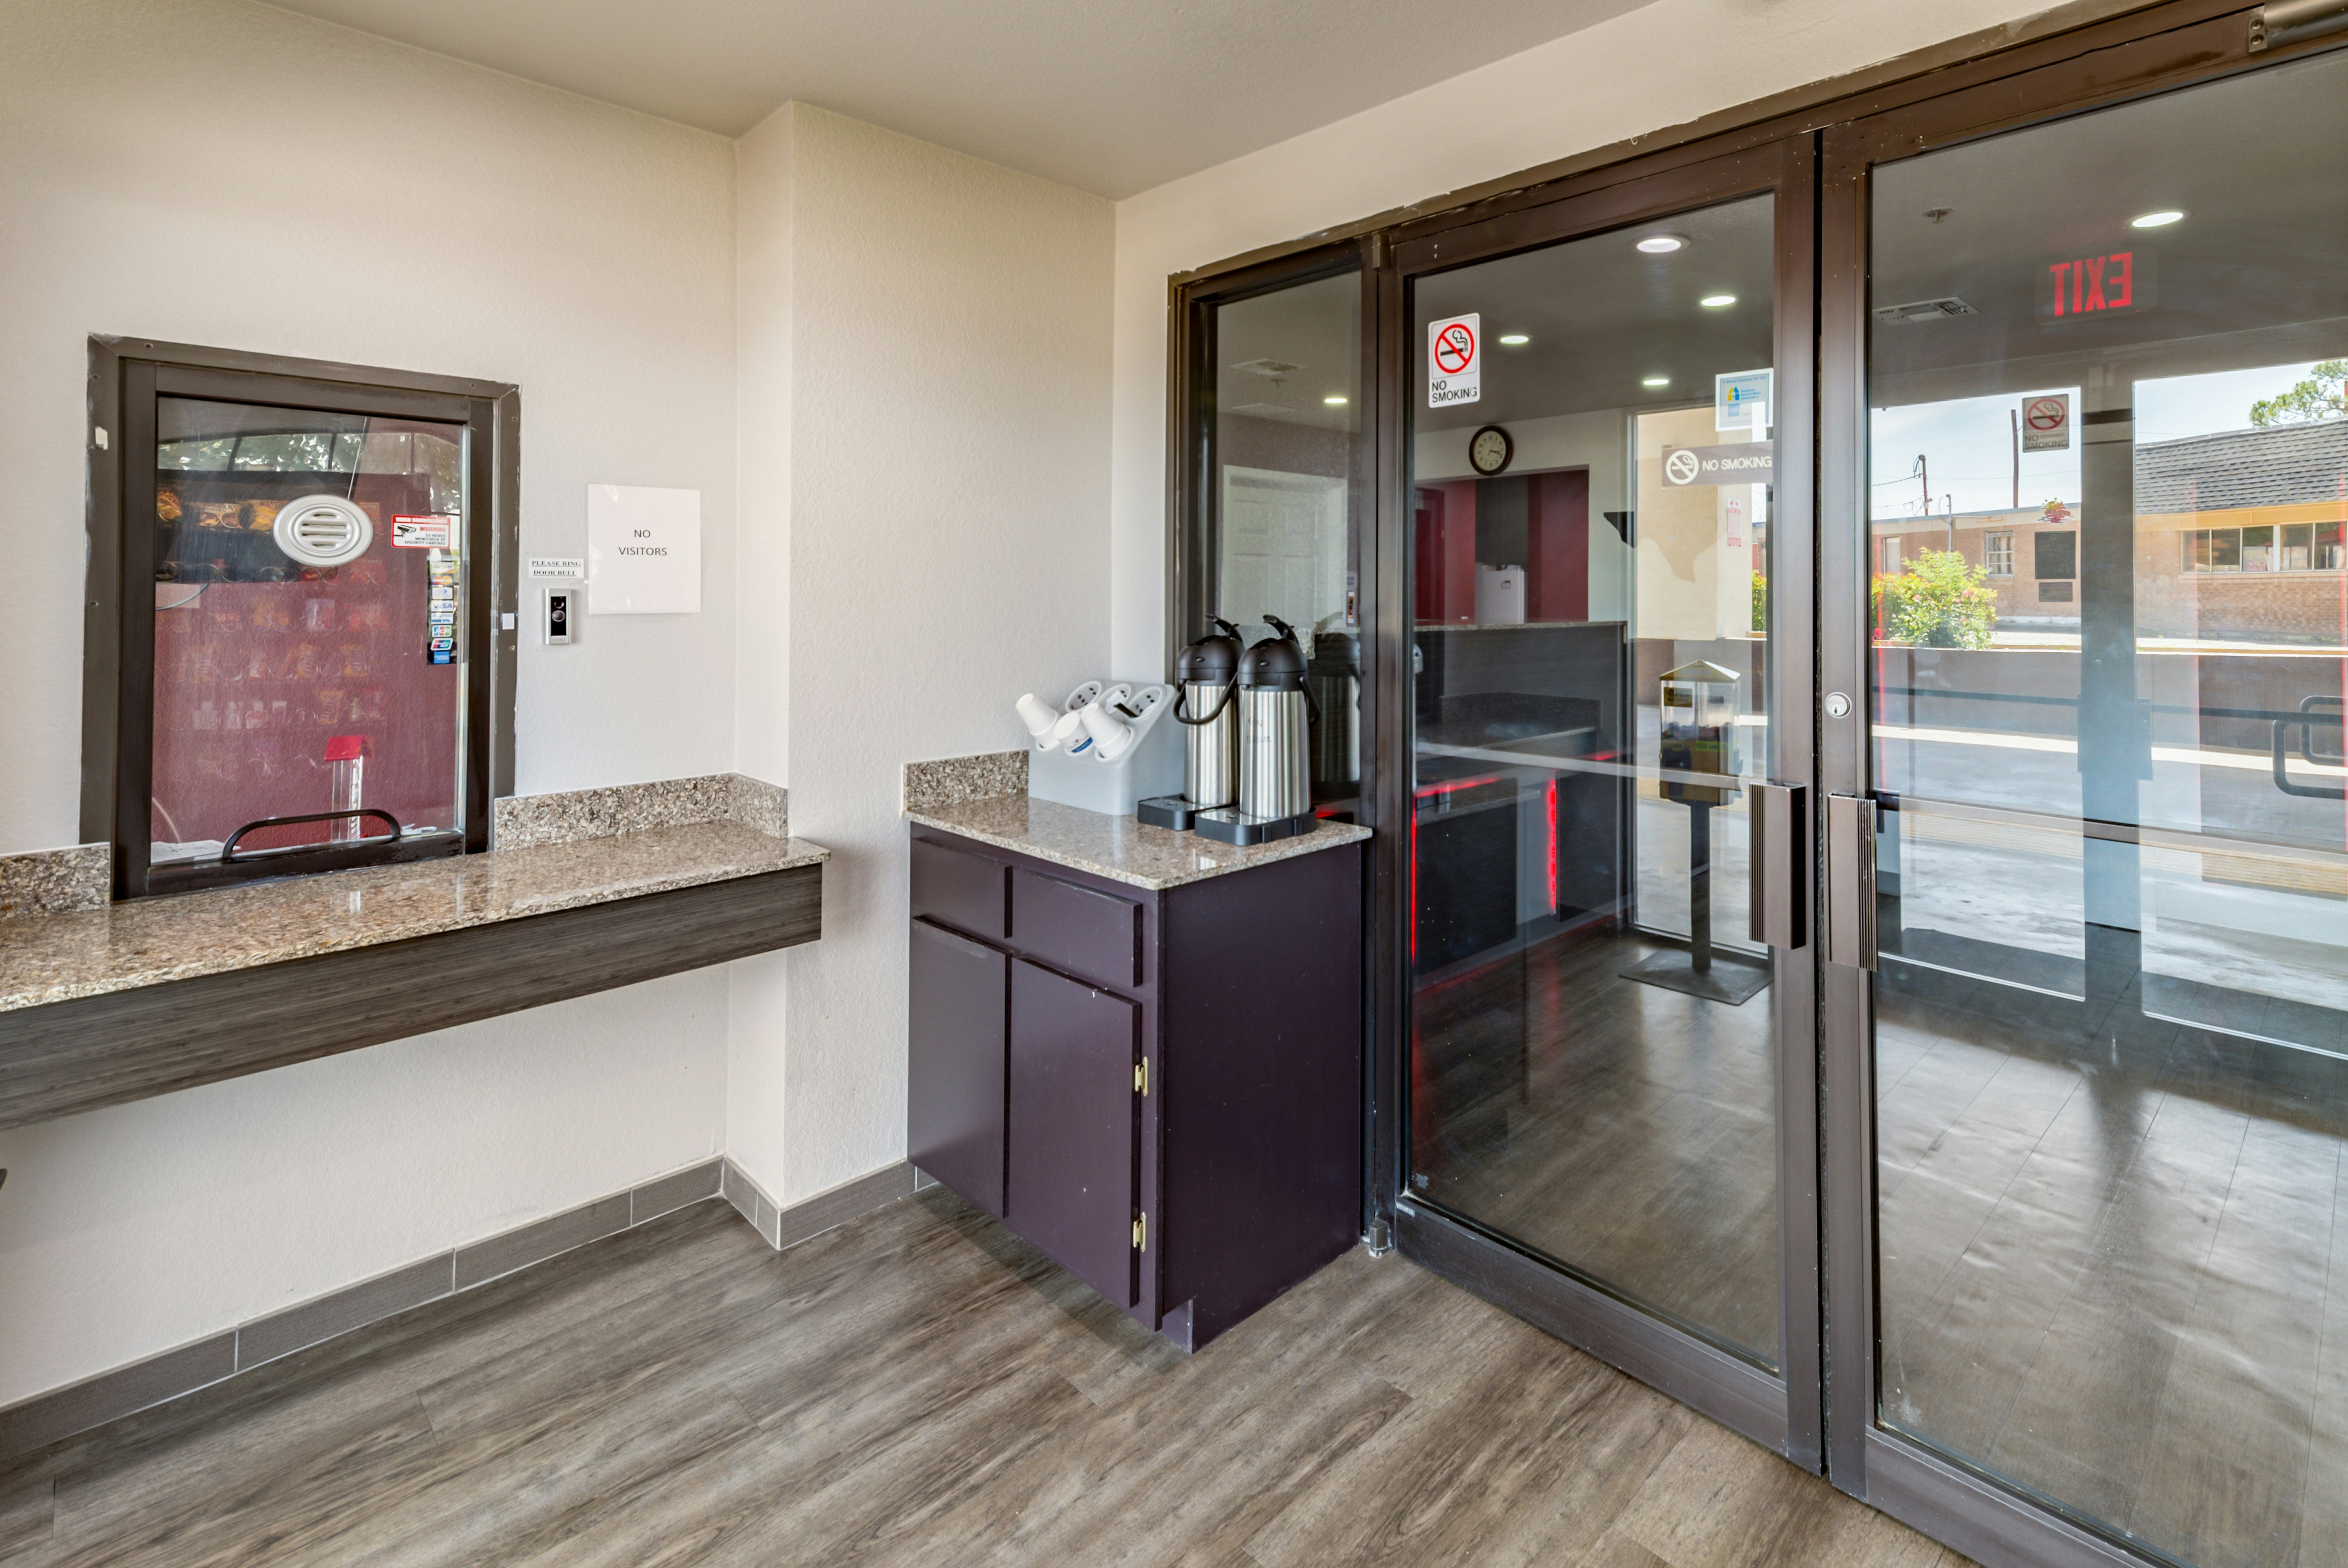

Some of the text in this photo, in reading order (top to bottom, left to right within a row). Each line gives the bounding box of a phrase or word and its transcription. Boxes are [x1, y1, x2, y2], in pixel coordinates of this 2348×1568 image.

[1432, 380, 1446, 391] NO
[1432, 387, 1477, 402] SMOKING
[2025, 439, 2067, 450] SMOKING
[1702, 456, 1772, 471] NO SMOKING
[634, 529, 651, 538] NO
[619, 547, 667, 556] VISITORS
